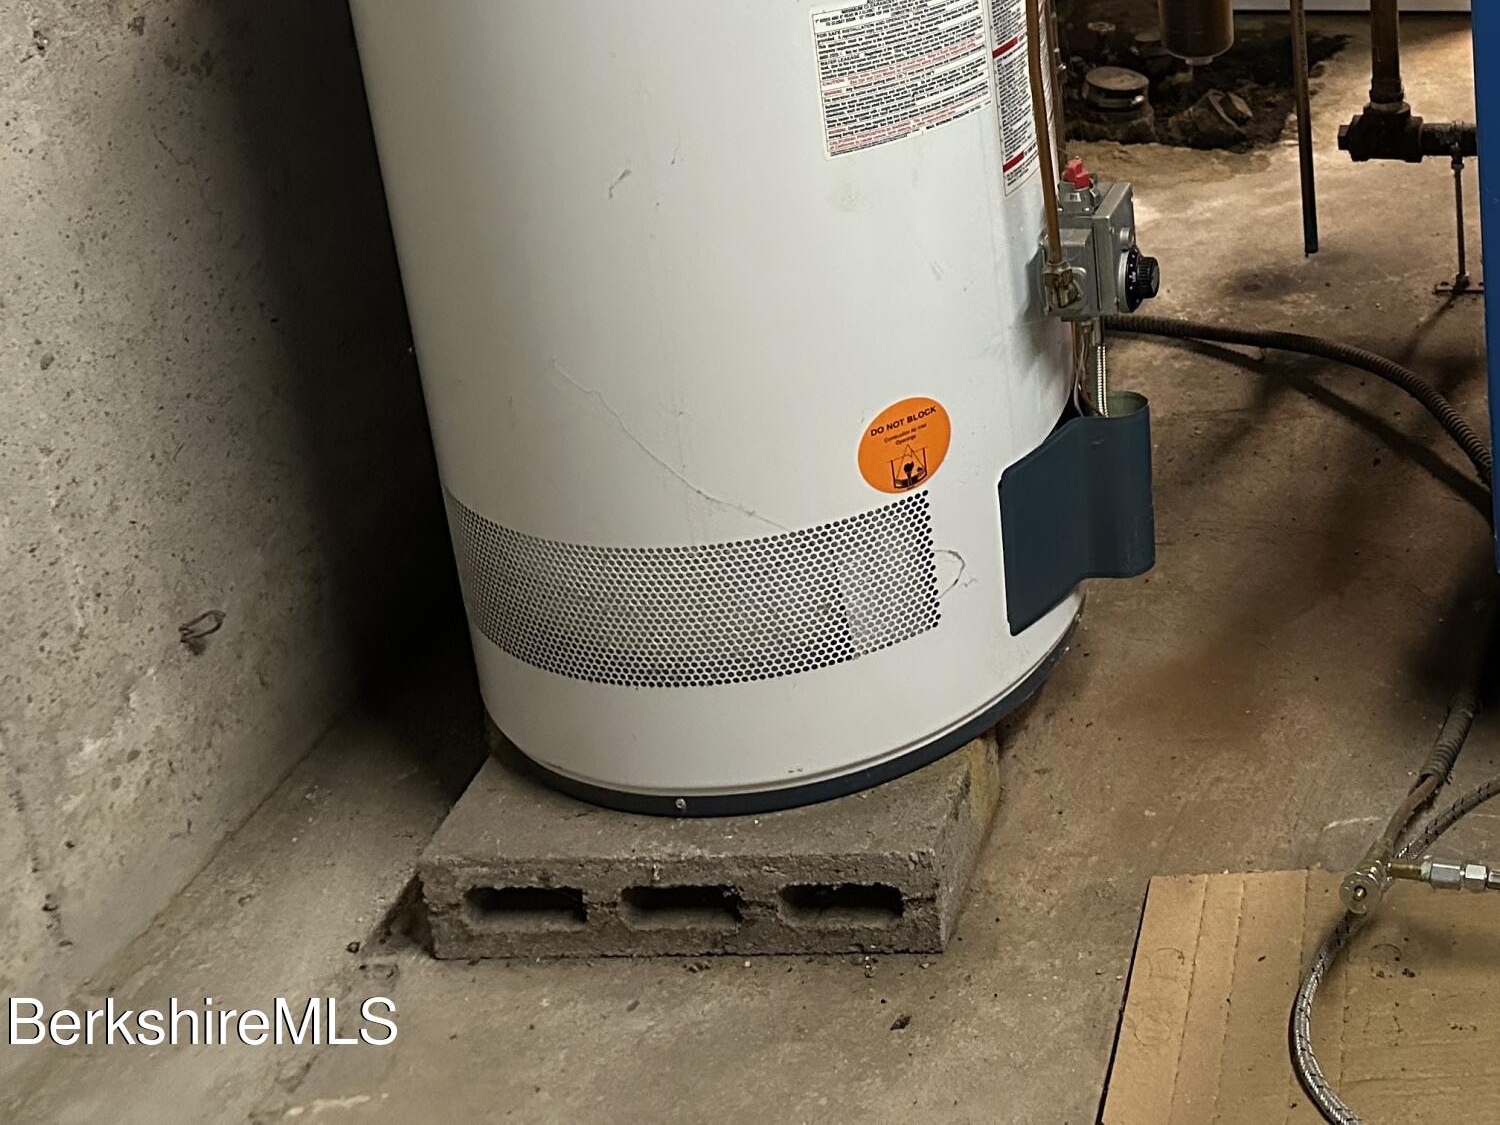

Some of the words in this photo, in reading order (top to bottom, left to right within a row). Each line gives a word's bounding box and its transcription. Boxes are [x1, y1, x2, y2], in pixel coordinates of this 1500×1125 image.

[870, 426, 885, 437] DO
[887, 419, 905, 430] NOT
[907, 406, 937, 423] BLOCK
